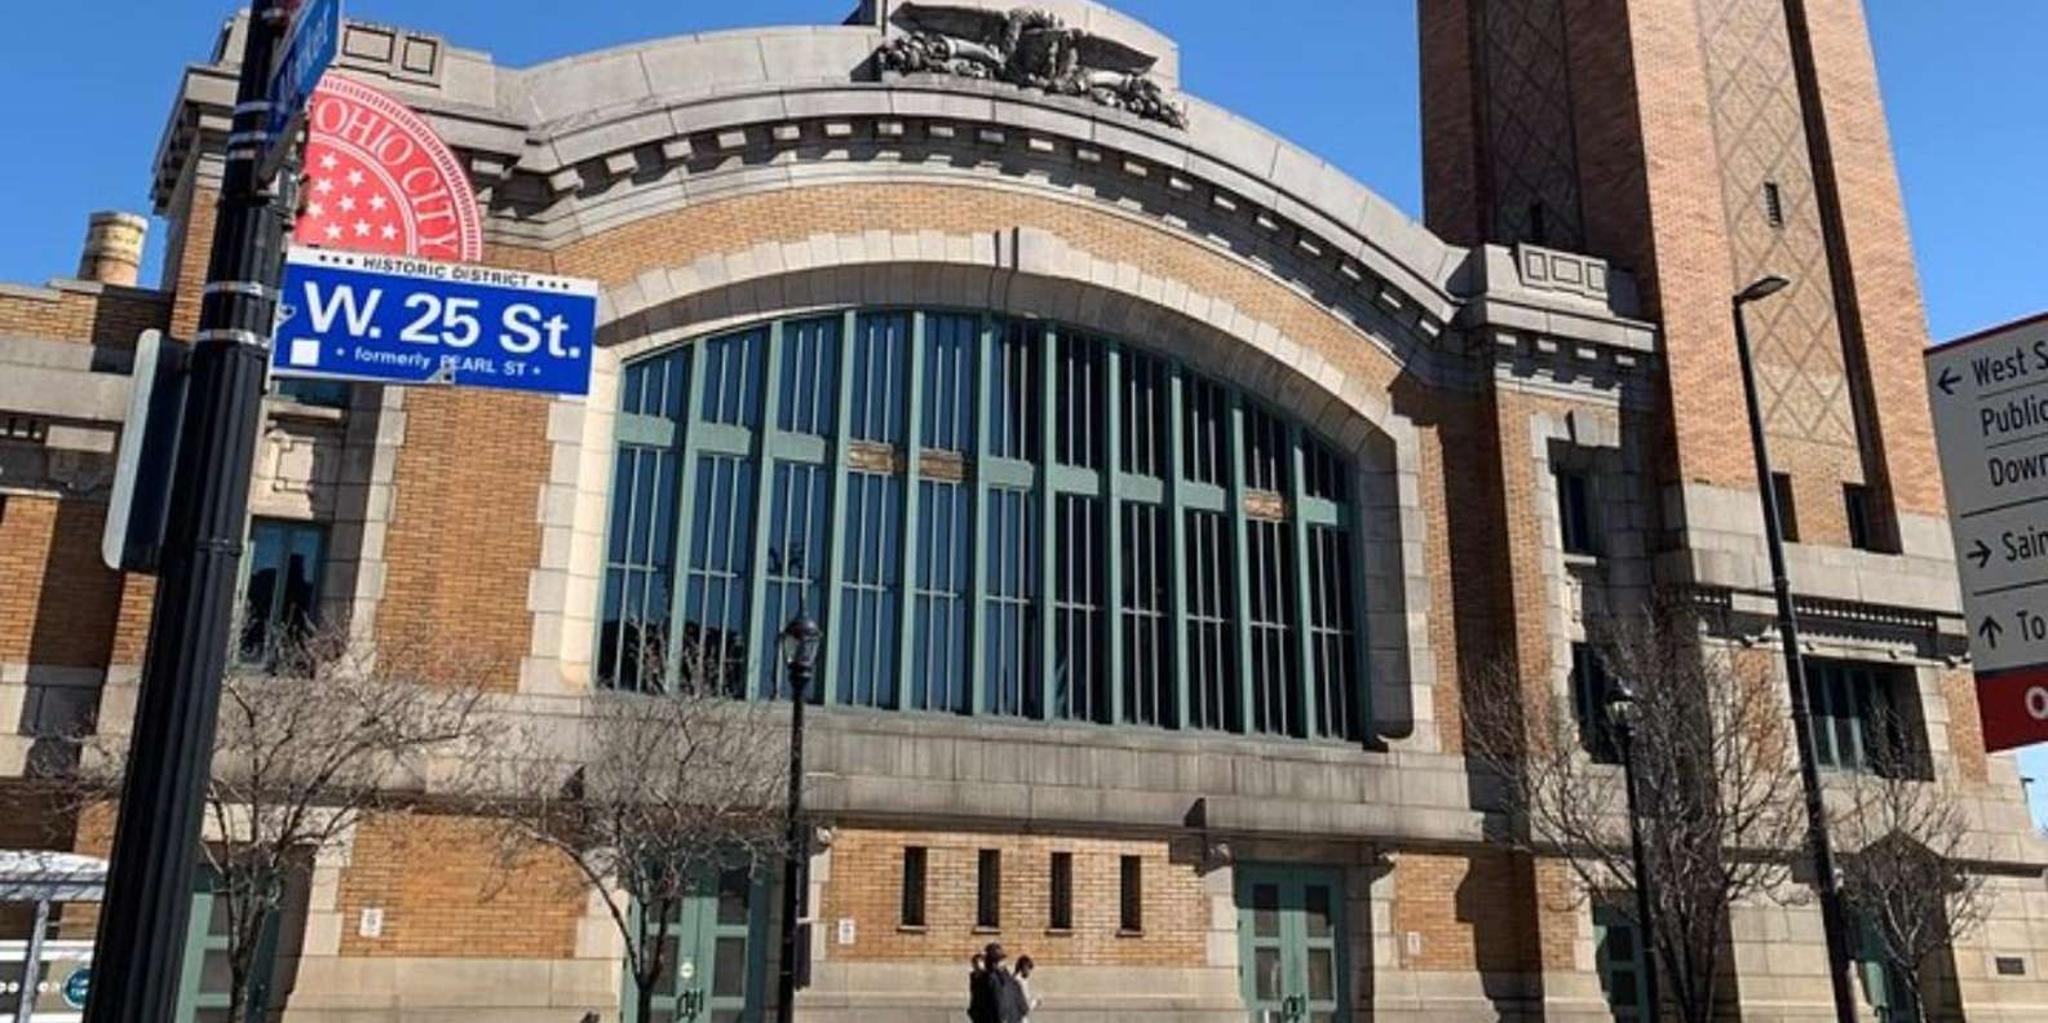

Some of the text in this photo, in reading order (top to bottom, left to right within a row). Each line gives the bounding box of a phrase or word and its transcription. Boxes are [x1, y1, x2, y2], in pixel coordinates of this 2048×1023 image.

[316, 98, 458, 255] OHIO CITY
[363, 256, 529, 288] HISTORIC DISTRICT
[304, 281, 581, 358] W. 25 St.
[354, 346, 526, 376] formerly PEARL ST
[1972, 347, 2027, 386] West
[1981, 394, 2048, 436] Public
[2016, 610, 2046, 642] To
